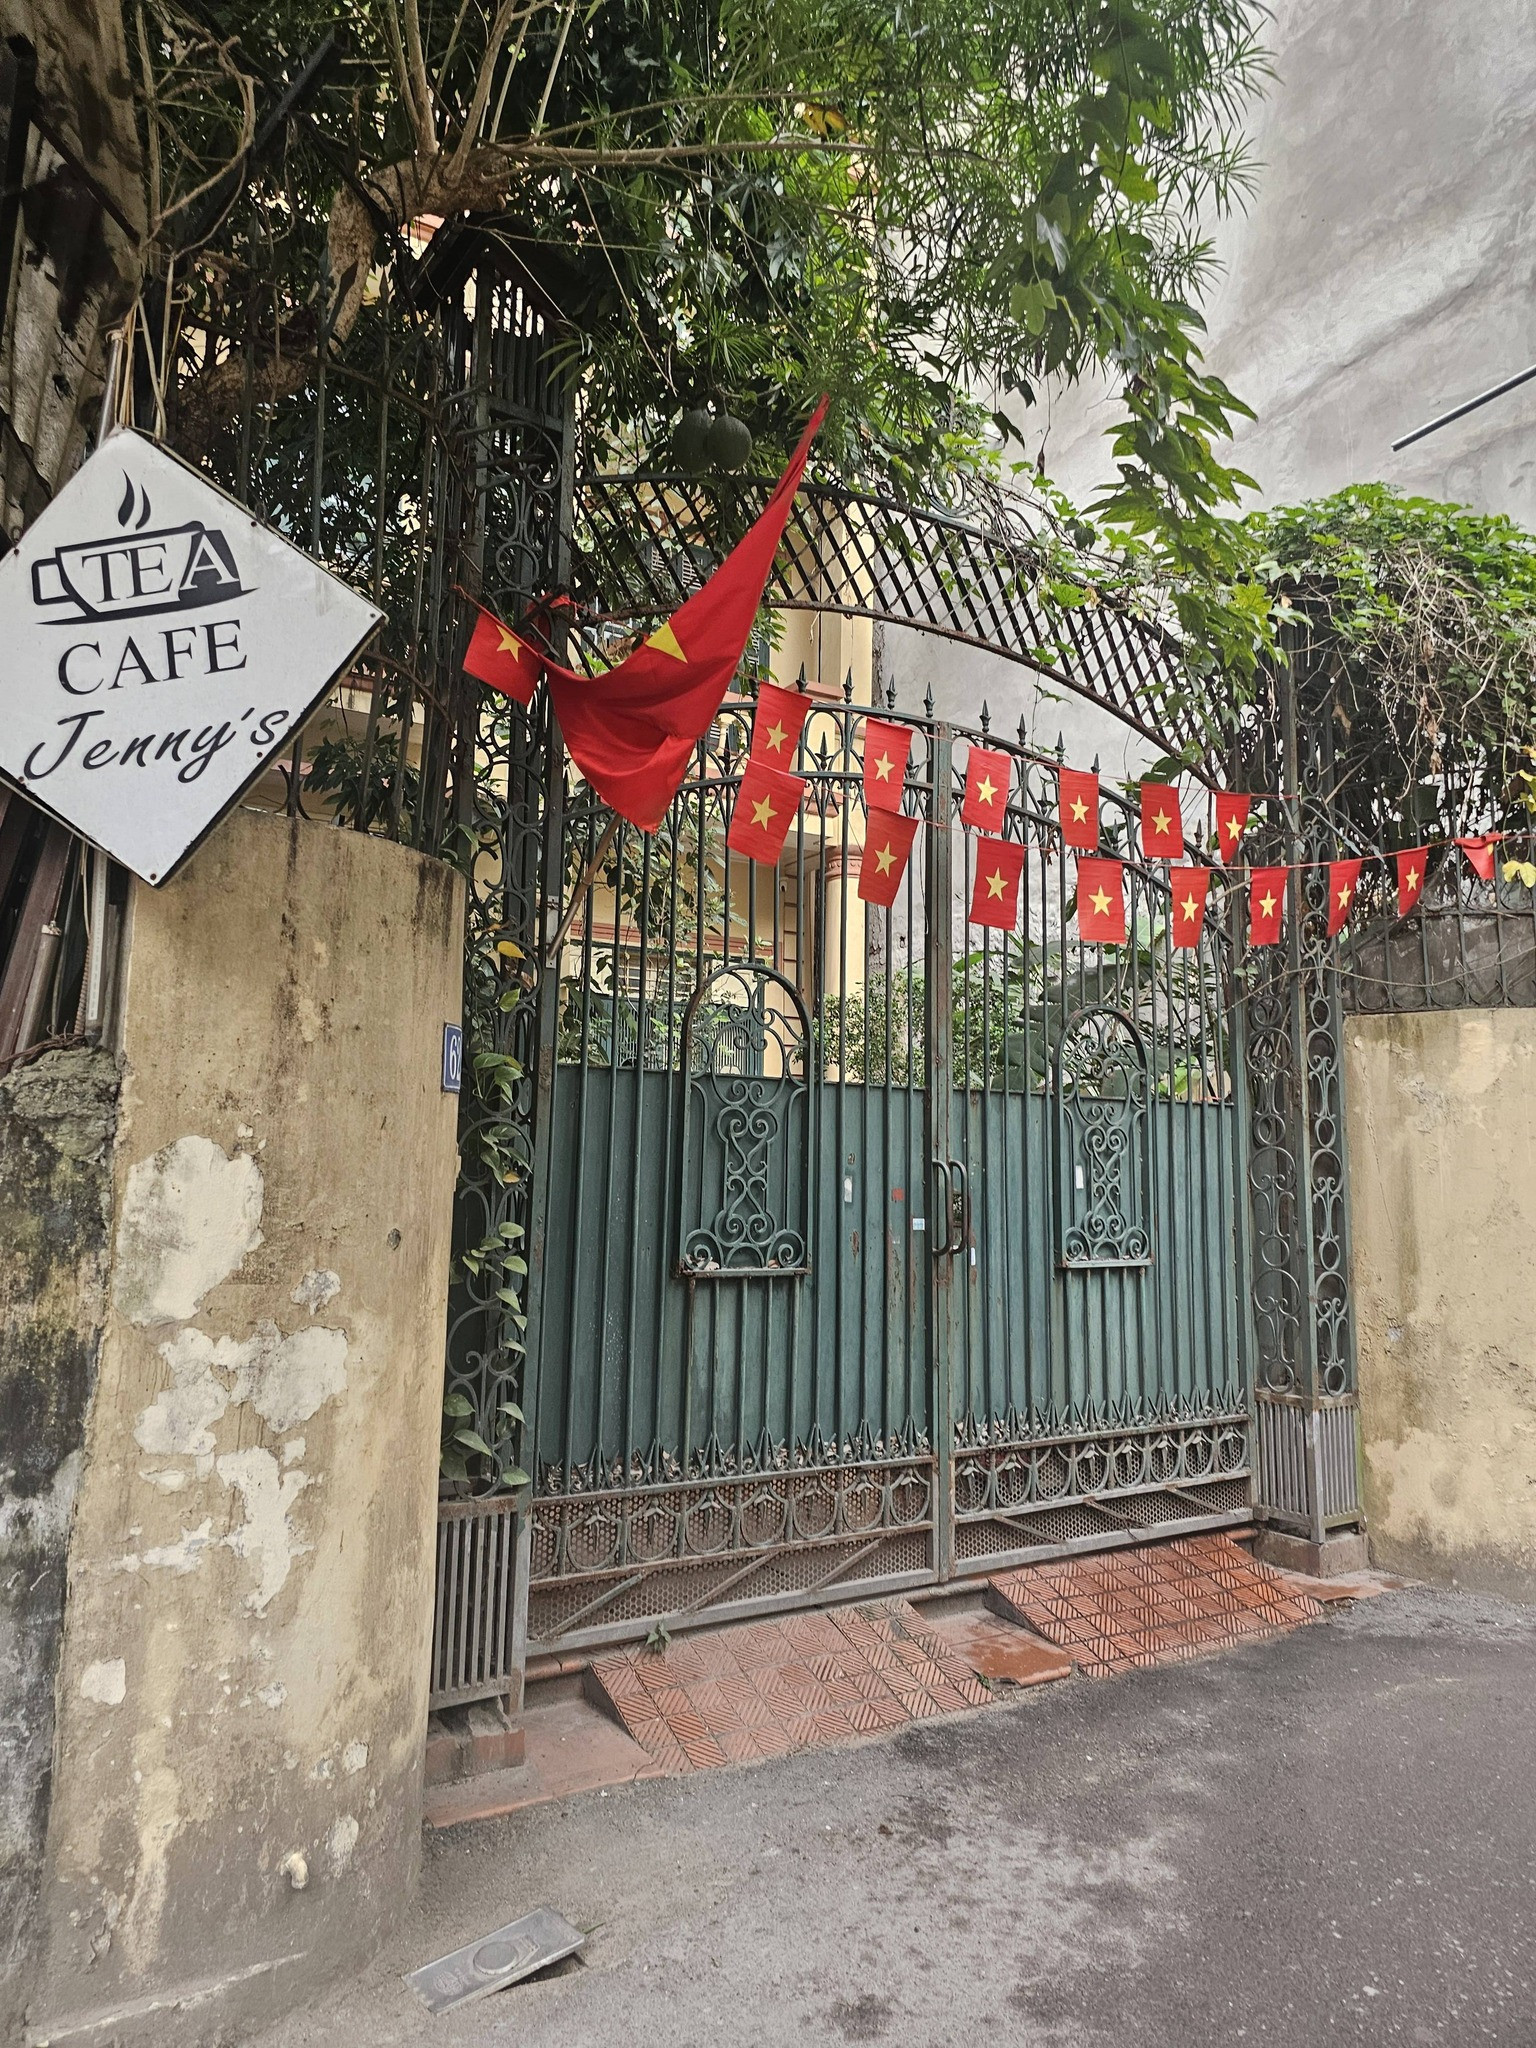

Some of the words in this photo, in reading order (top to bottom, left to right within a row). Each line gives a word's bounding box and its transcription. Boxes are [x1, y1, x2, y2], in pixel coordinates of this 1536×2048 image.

[81, 534, 241, 604] TEA
[58, 619, 248, 696] CAFE
[23, 707, 290, 784] Jenny's
